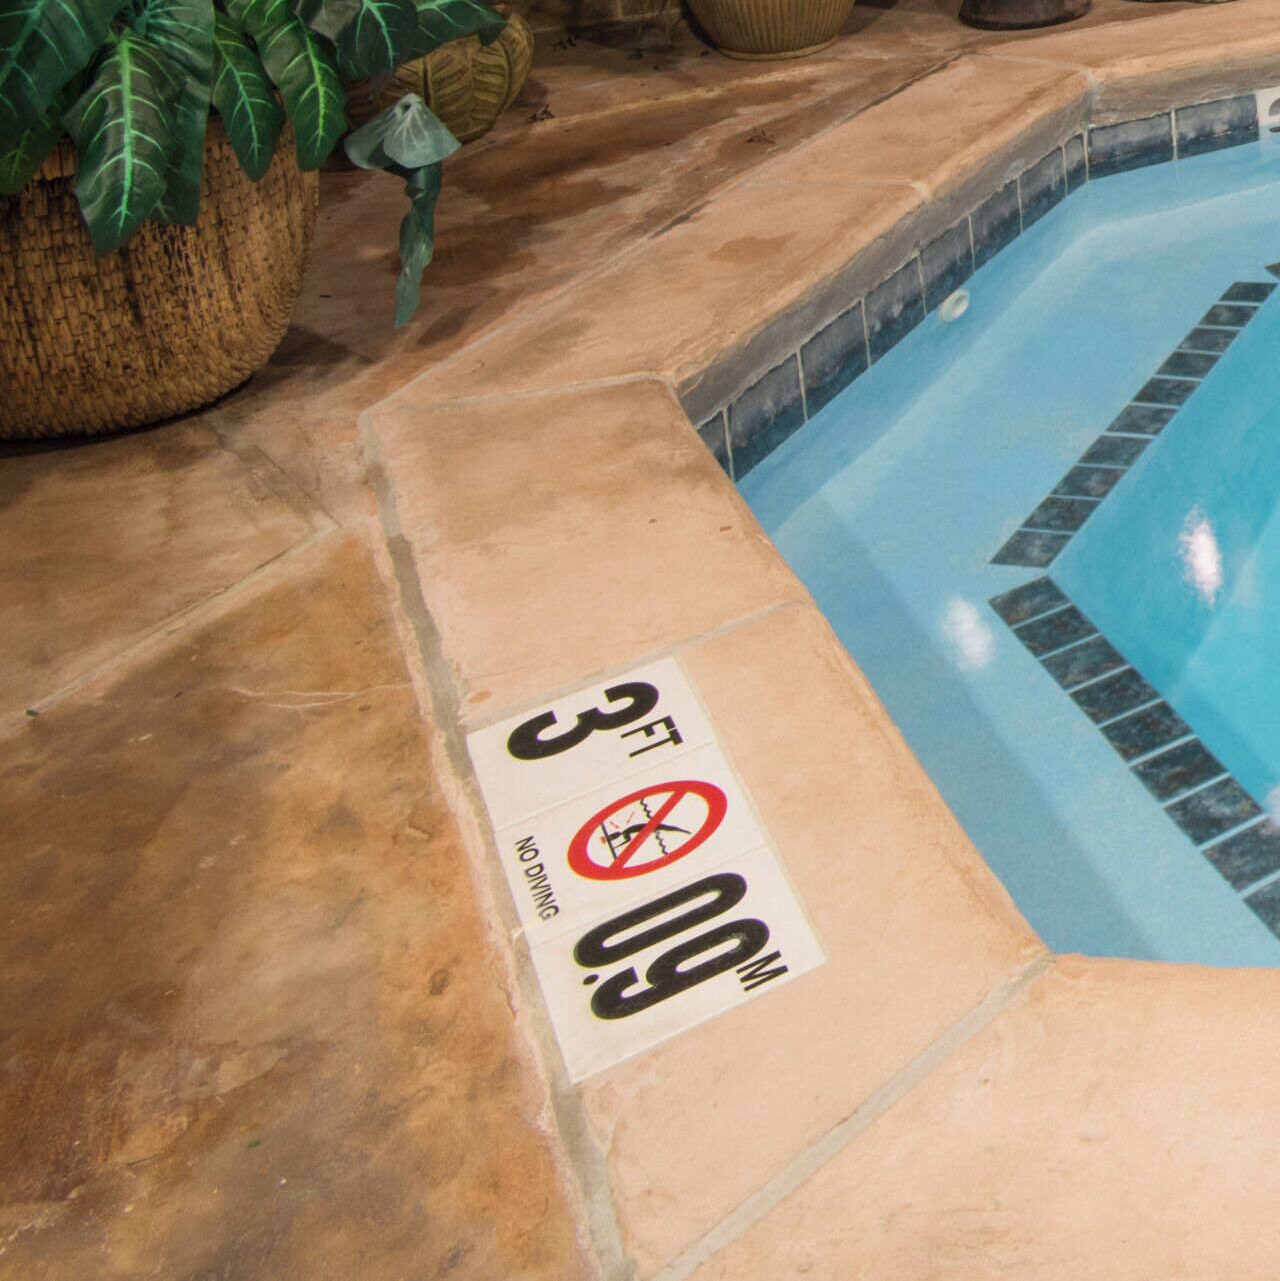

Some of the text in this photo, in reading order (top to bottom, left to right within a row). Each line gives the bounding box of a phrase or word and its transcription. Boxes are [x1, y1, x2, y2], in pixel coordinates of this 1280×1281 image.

[507, 682, 684, 760] 3 FT
[514, 836, 560, 921] NO DIVING
[574, 872, 788, 1020] 0.9 M
